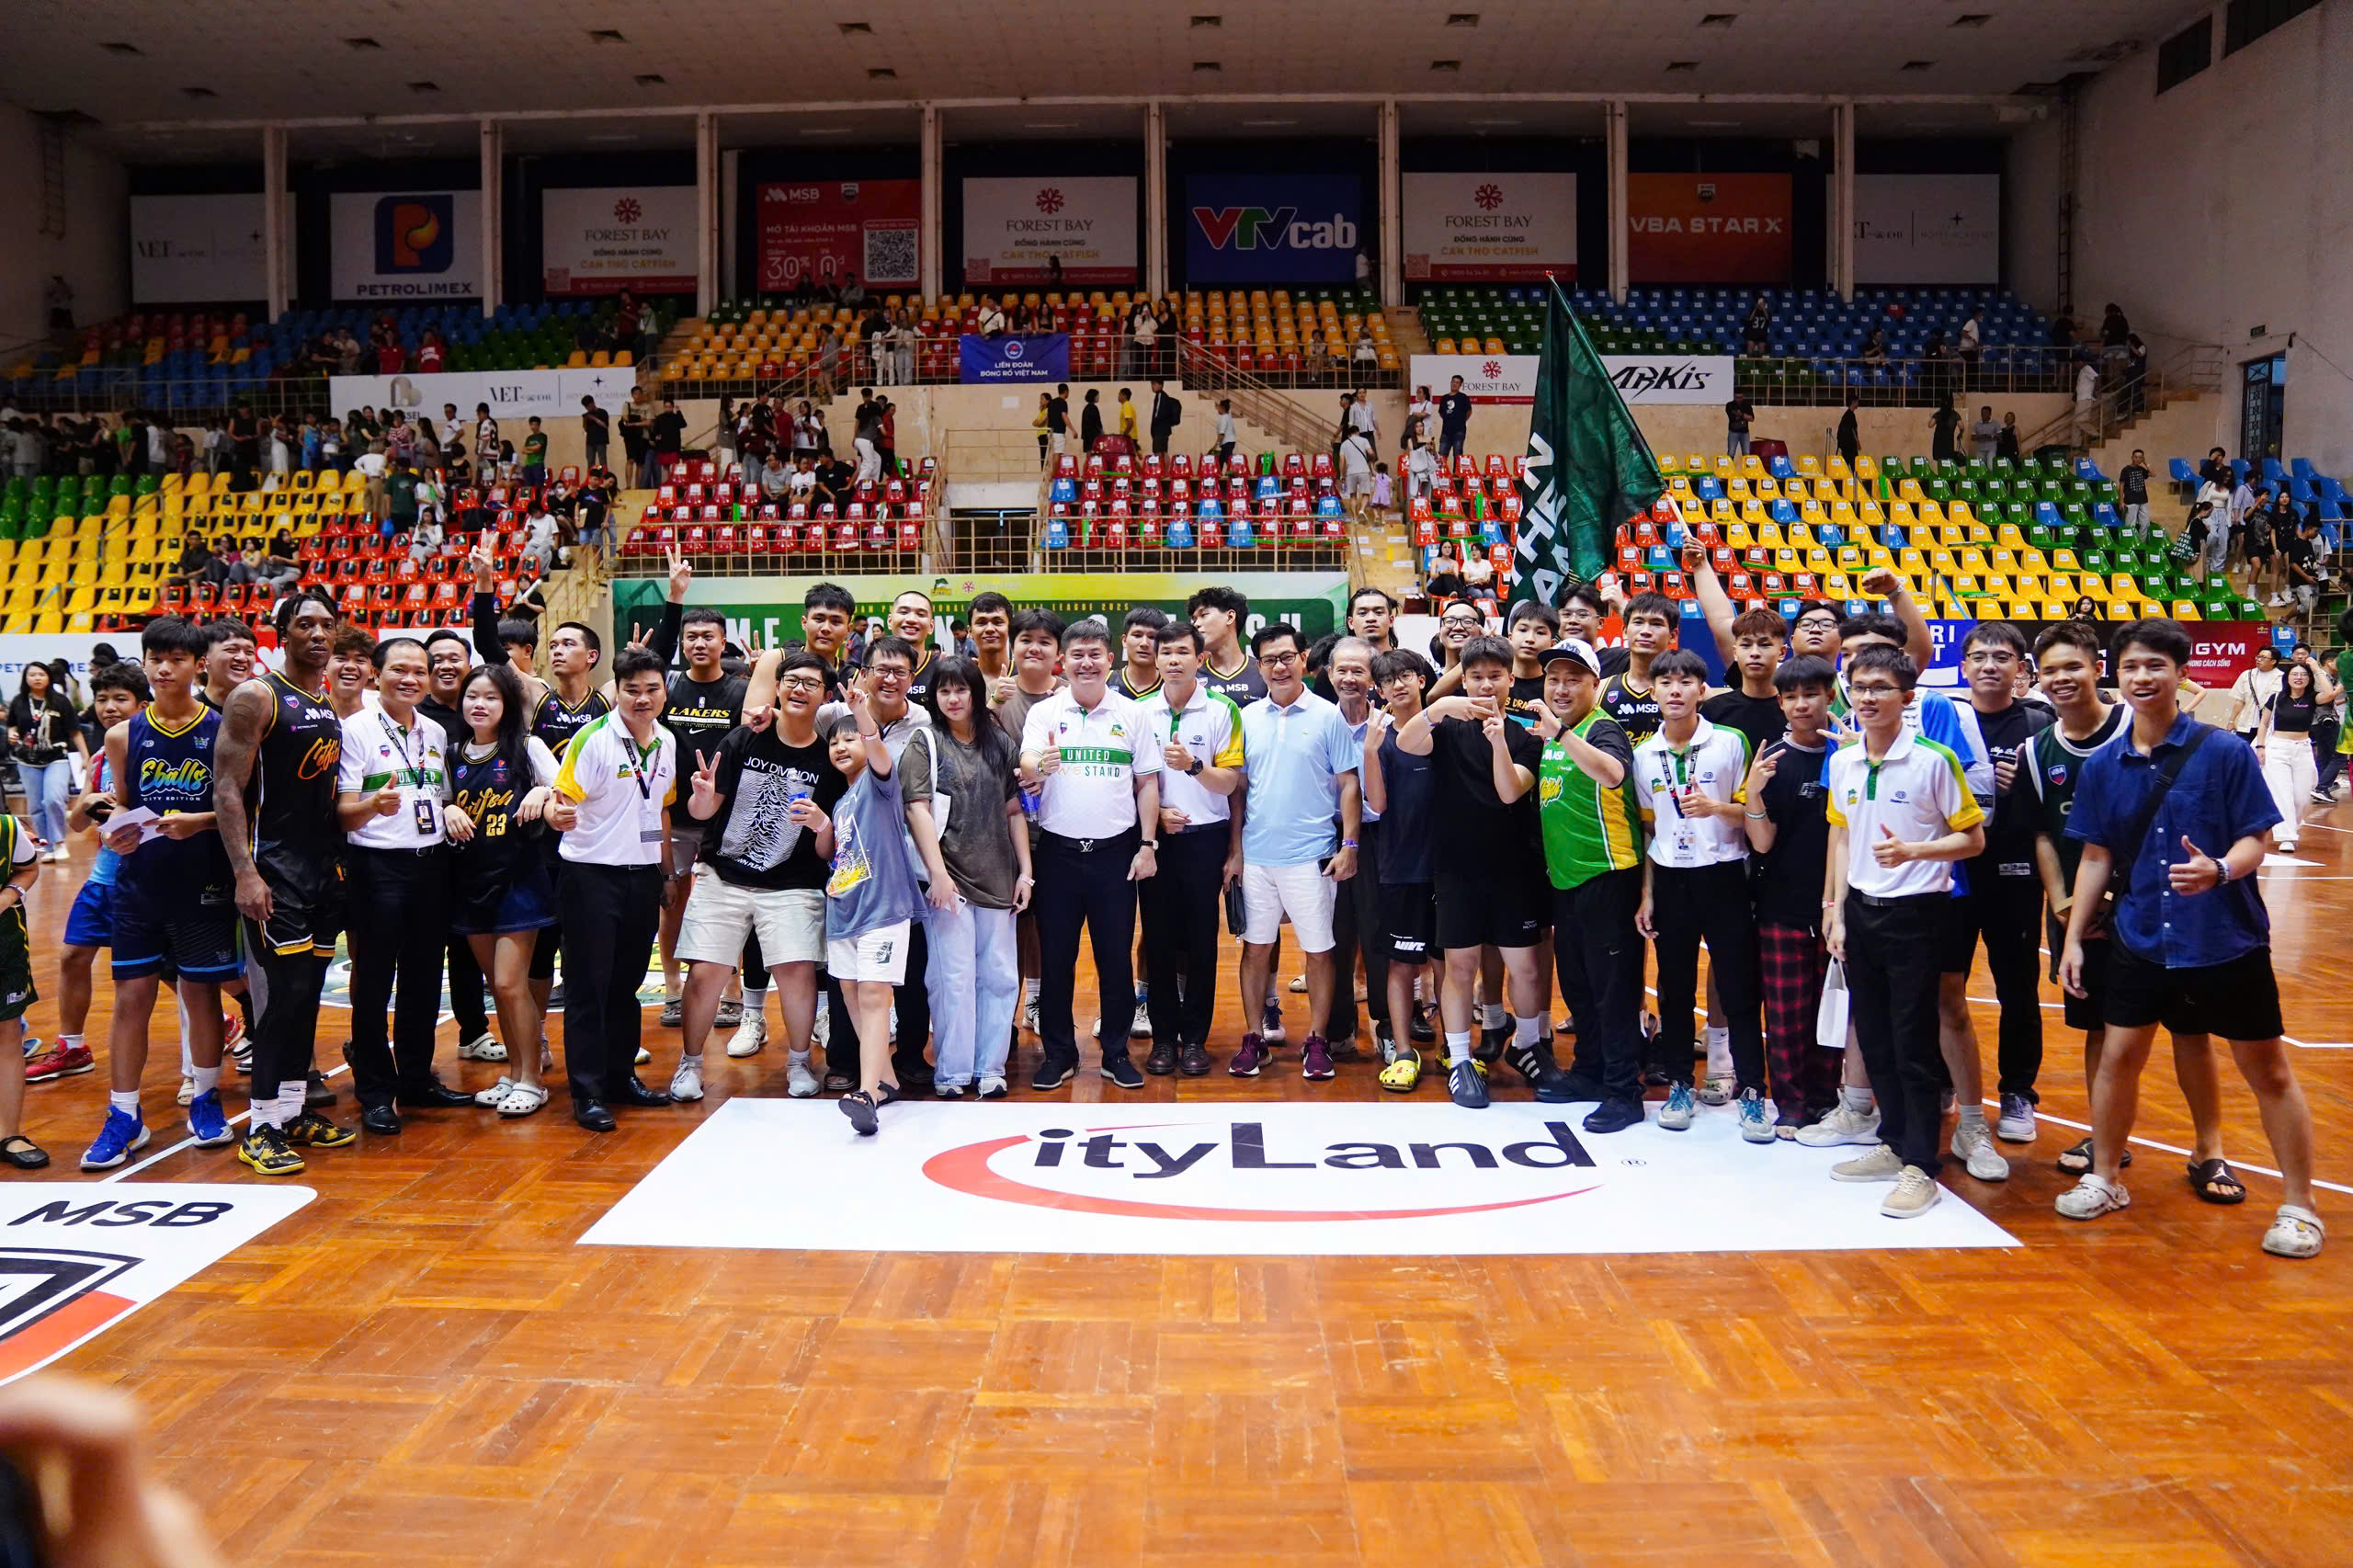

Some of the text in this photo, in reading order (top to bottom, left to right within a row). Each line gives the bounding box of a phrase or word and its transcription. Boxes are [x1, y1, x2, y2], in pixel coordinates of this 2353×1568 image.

[789, 187, 820, 200] MSB
[837, 223, 858, 233] MSB
[1006, 219, 1093, 232] FOREST BAY
[1445, 215, 1533, 228] FOREST BAY
[1631, 217, 1783, 233] VBA STAR X
[584, 228, 670, 241] FOREST BAY
[356, 281, 472, 296] PETROLIMEX
[1462, 382, 1521, 392] FOREST BAY
[1051, 602, 1094, 611] LEAGUE
[1101, 602, 1131, 611] 2025
[1226, 683, 1249, 693] MSB
[668, 706, 732, 719] LAKERS
[1635, 703, 1659, 714] MSB
[571, 713, 592, 724] MSB
[1066, 749, 1110, 762] UNITED
[744, 756, 769, 770] JOY
[1084, 766, 1120, 778] STAND
[485, 813, 507, 837] 23
[1393, 940, 1426, 952] NIKE
[6, 1200, 234, 1227] MSB
